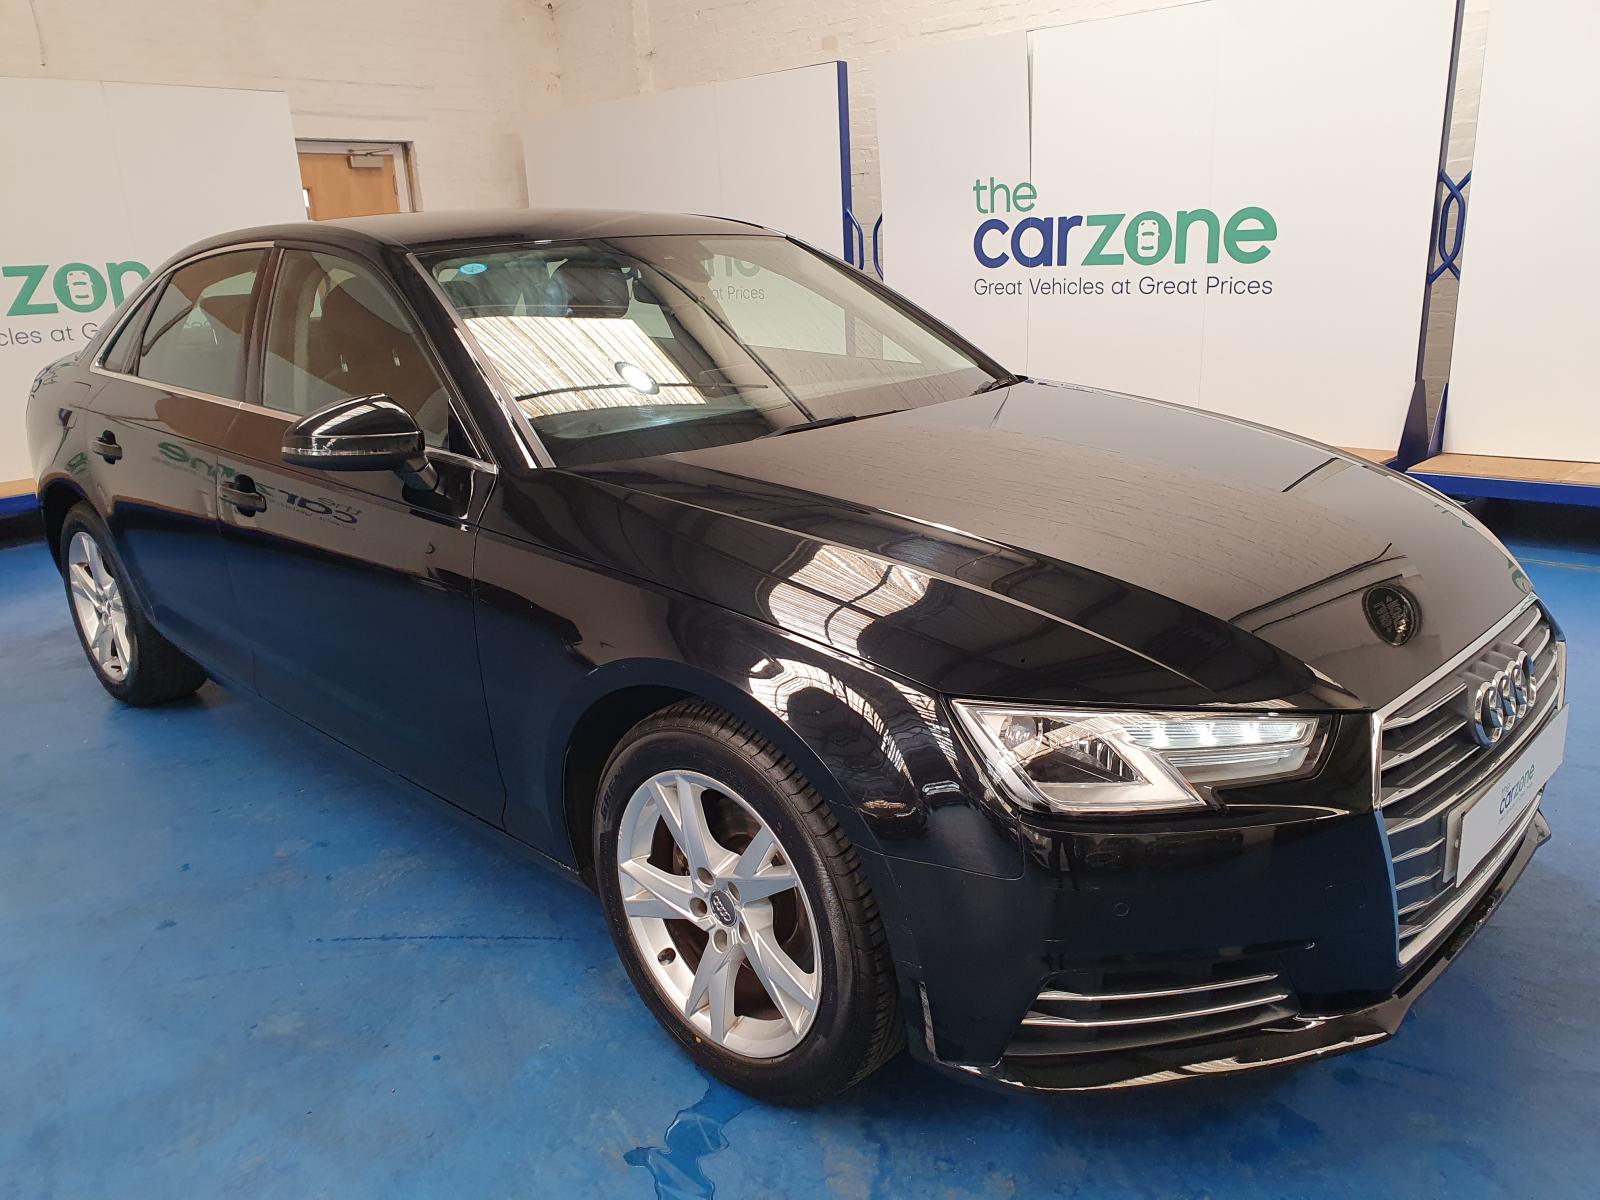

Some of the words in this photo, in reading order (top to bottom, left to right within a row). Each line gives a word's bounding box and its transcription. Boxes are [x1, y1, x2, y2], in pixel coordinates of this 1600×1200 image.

[973, 177, 1038, 214] the
[973, 206, 1278, 269] carzone
[727, 285, 765, 300] Prices
[973, 278, 1023, 295] Great
[1029, 277, 1105, 295] Vehicles
[1111, 278, 1132, 295] at
[1138, 276, 1198, 295] Great
[1206, 276, 1274, 295] Prices
[50, 325, 75, 343] at
